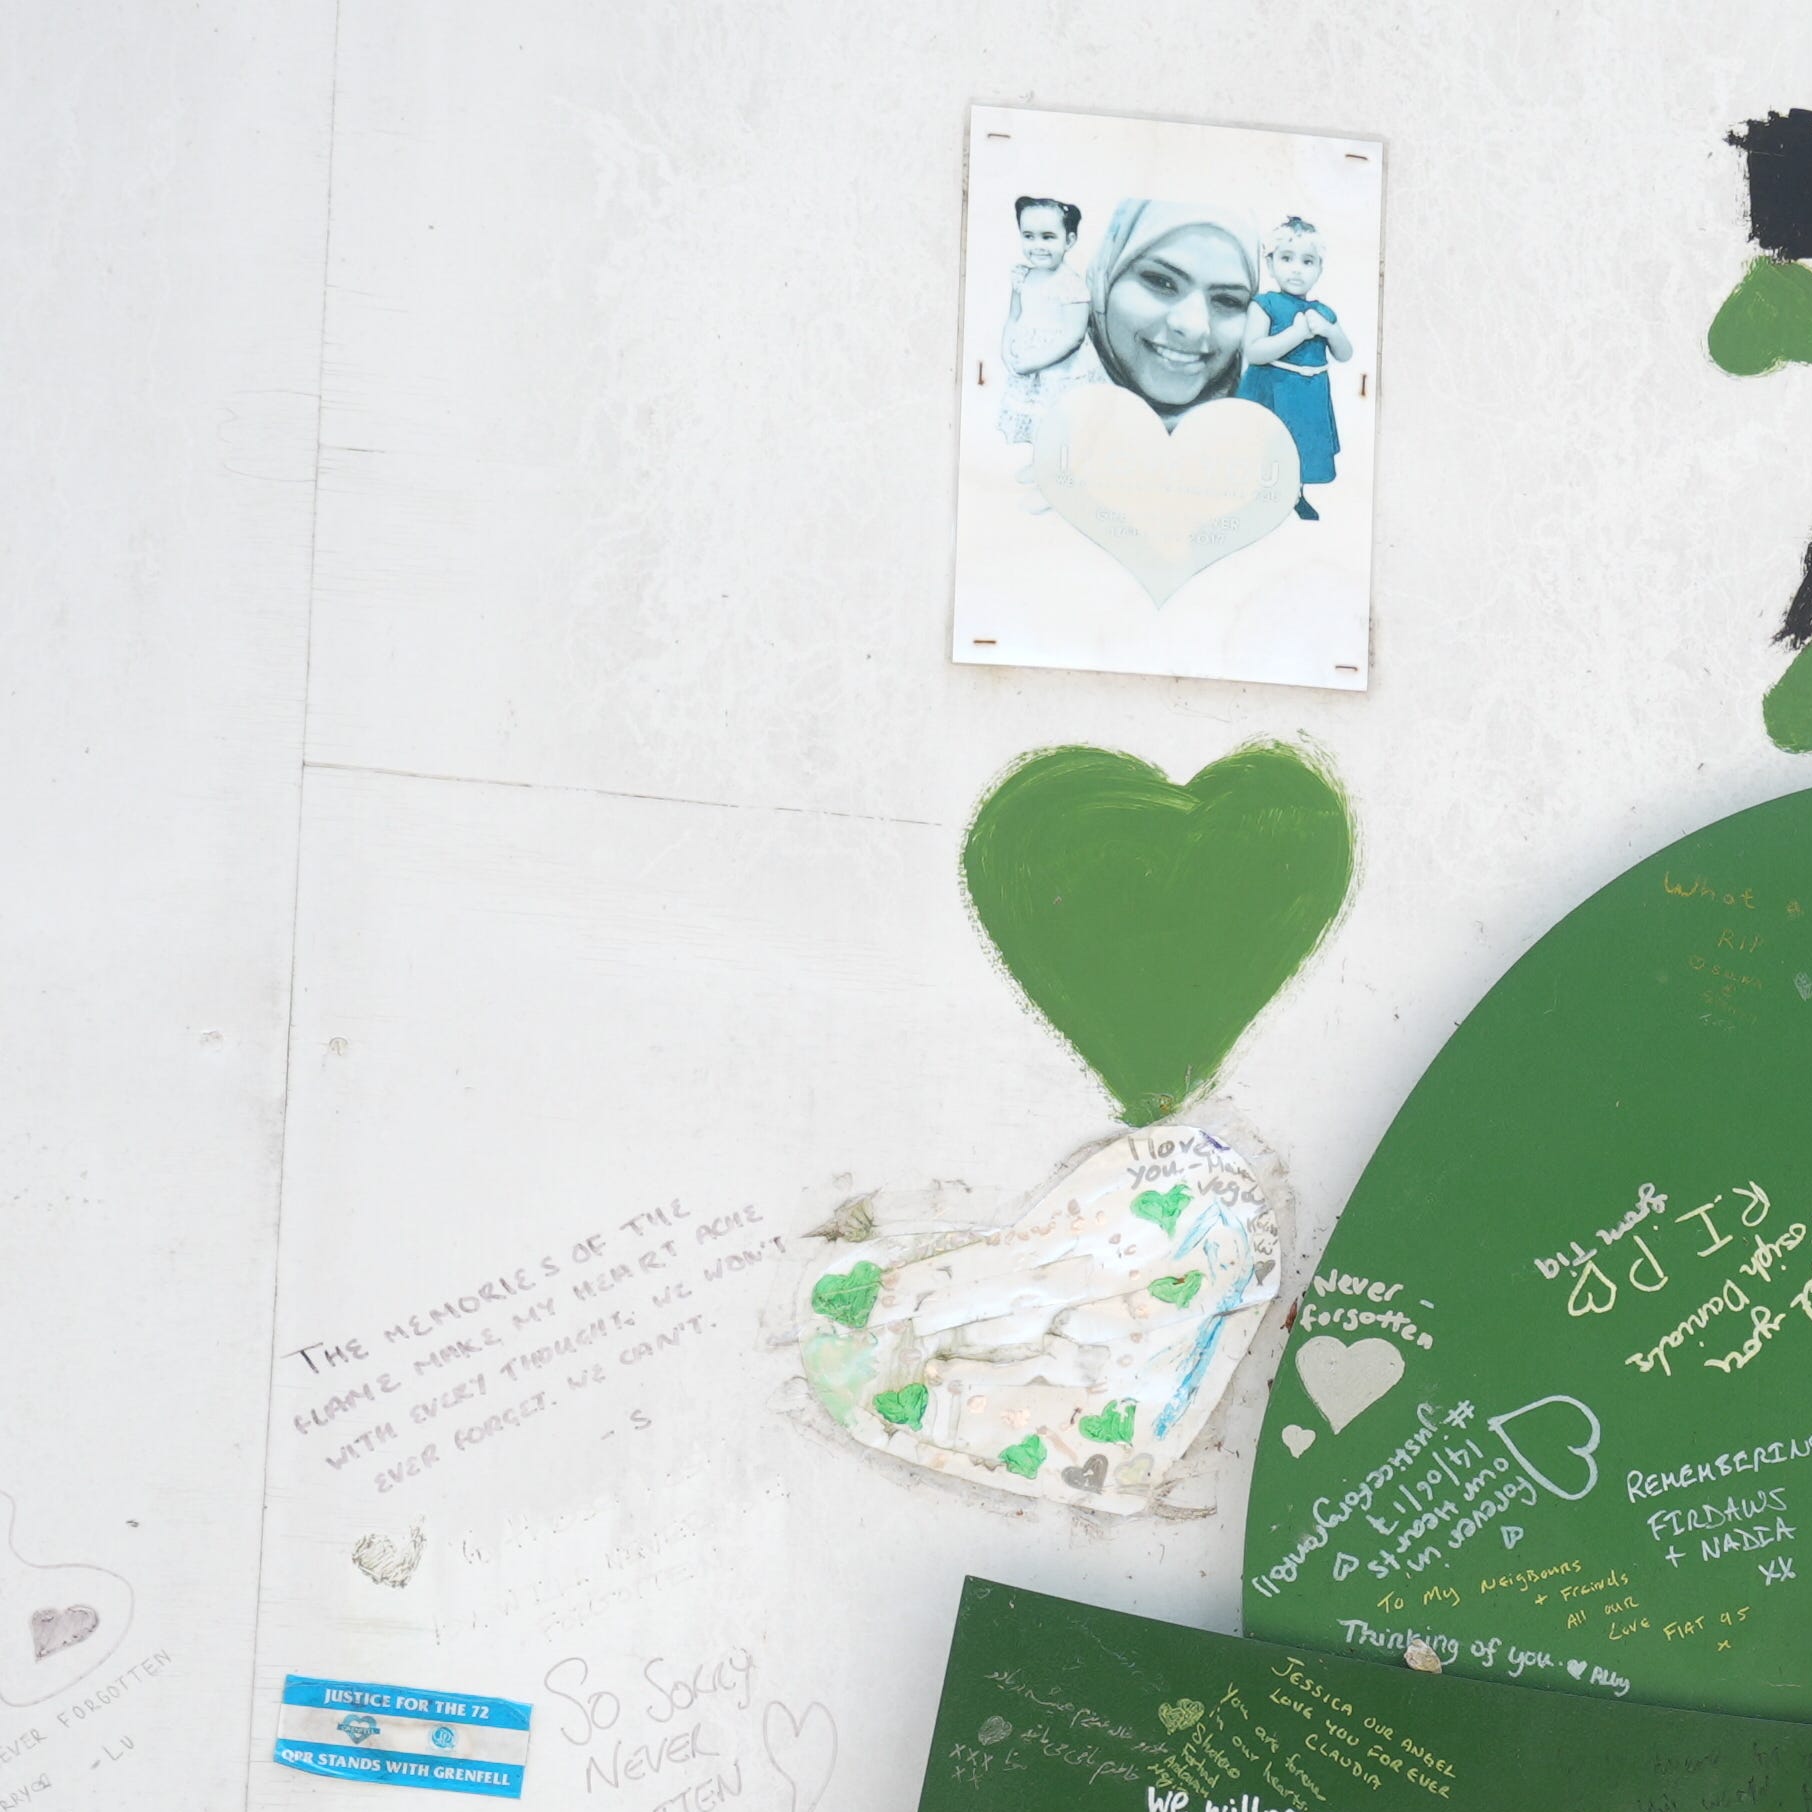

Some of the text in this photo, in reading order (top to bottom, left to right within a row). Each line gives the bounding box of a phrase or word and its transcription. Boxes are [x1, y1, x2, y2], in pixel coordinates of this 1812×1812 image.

[1314, 1268, 1404, 1303] Never
[1647, 1488, 1786, 1539] FIRDAWS
[1702, 1519, 1797, 1561] NADIA
[1470, 1636, 1500, 1667] of
[324, 1688, 490, 1719] JUSTICE FOR THE 72
[1269, 1686, 1361, 1746] LOVE YOU
[1271, 1658, 1456, 1778] JESSICA OUR ANGEL
[281, 1749, 510, 1786] QPR STANDS WITH GRENFELL
[584, 1724, 721, 1795] NEVER
[1305, 1733, 1382, 1791] CLAUDIA
